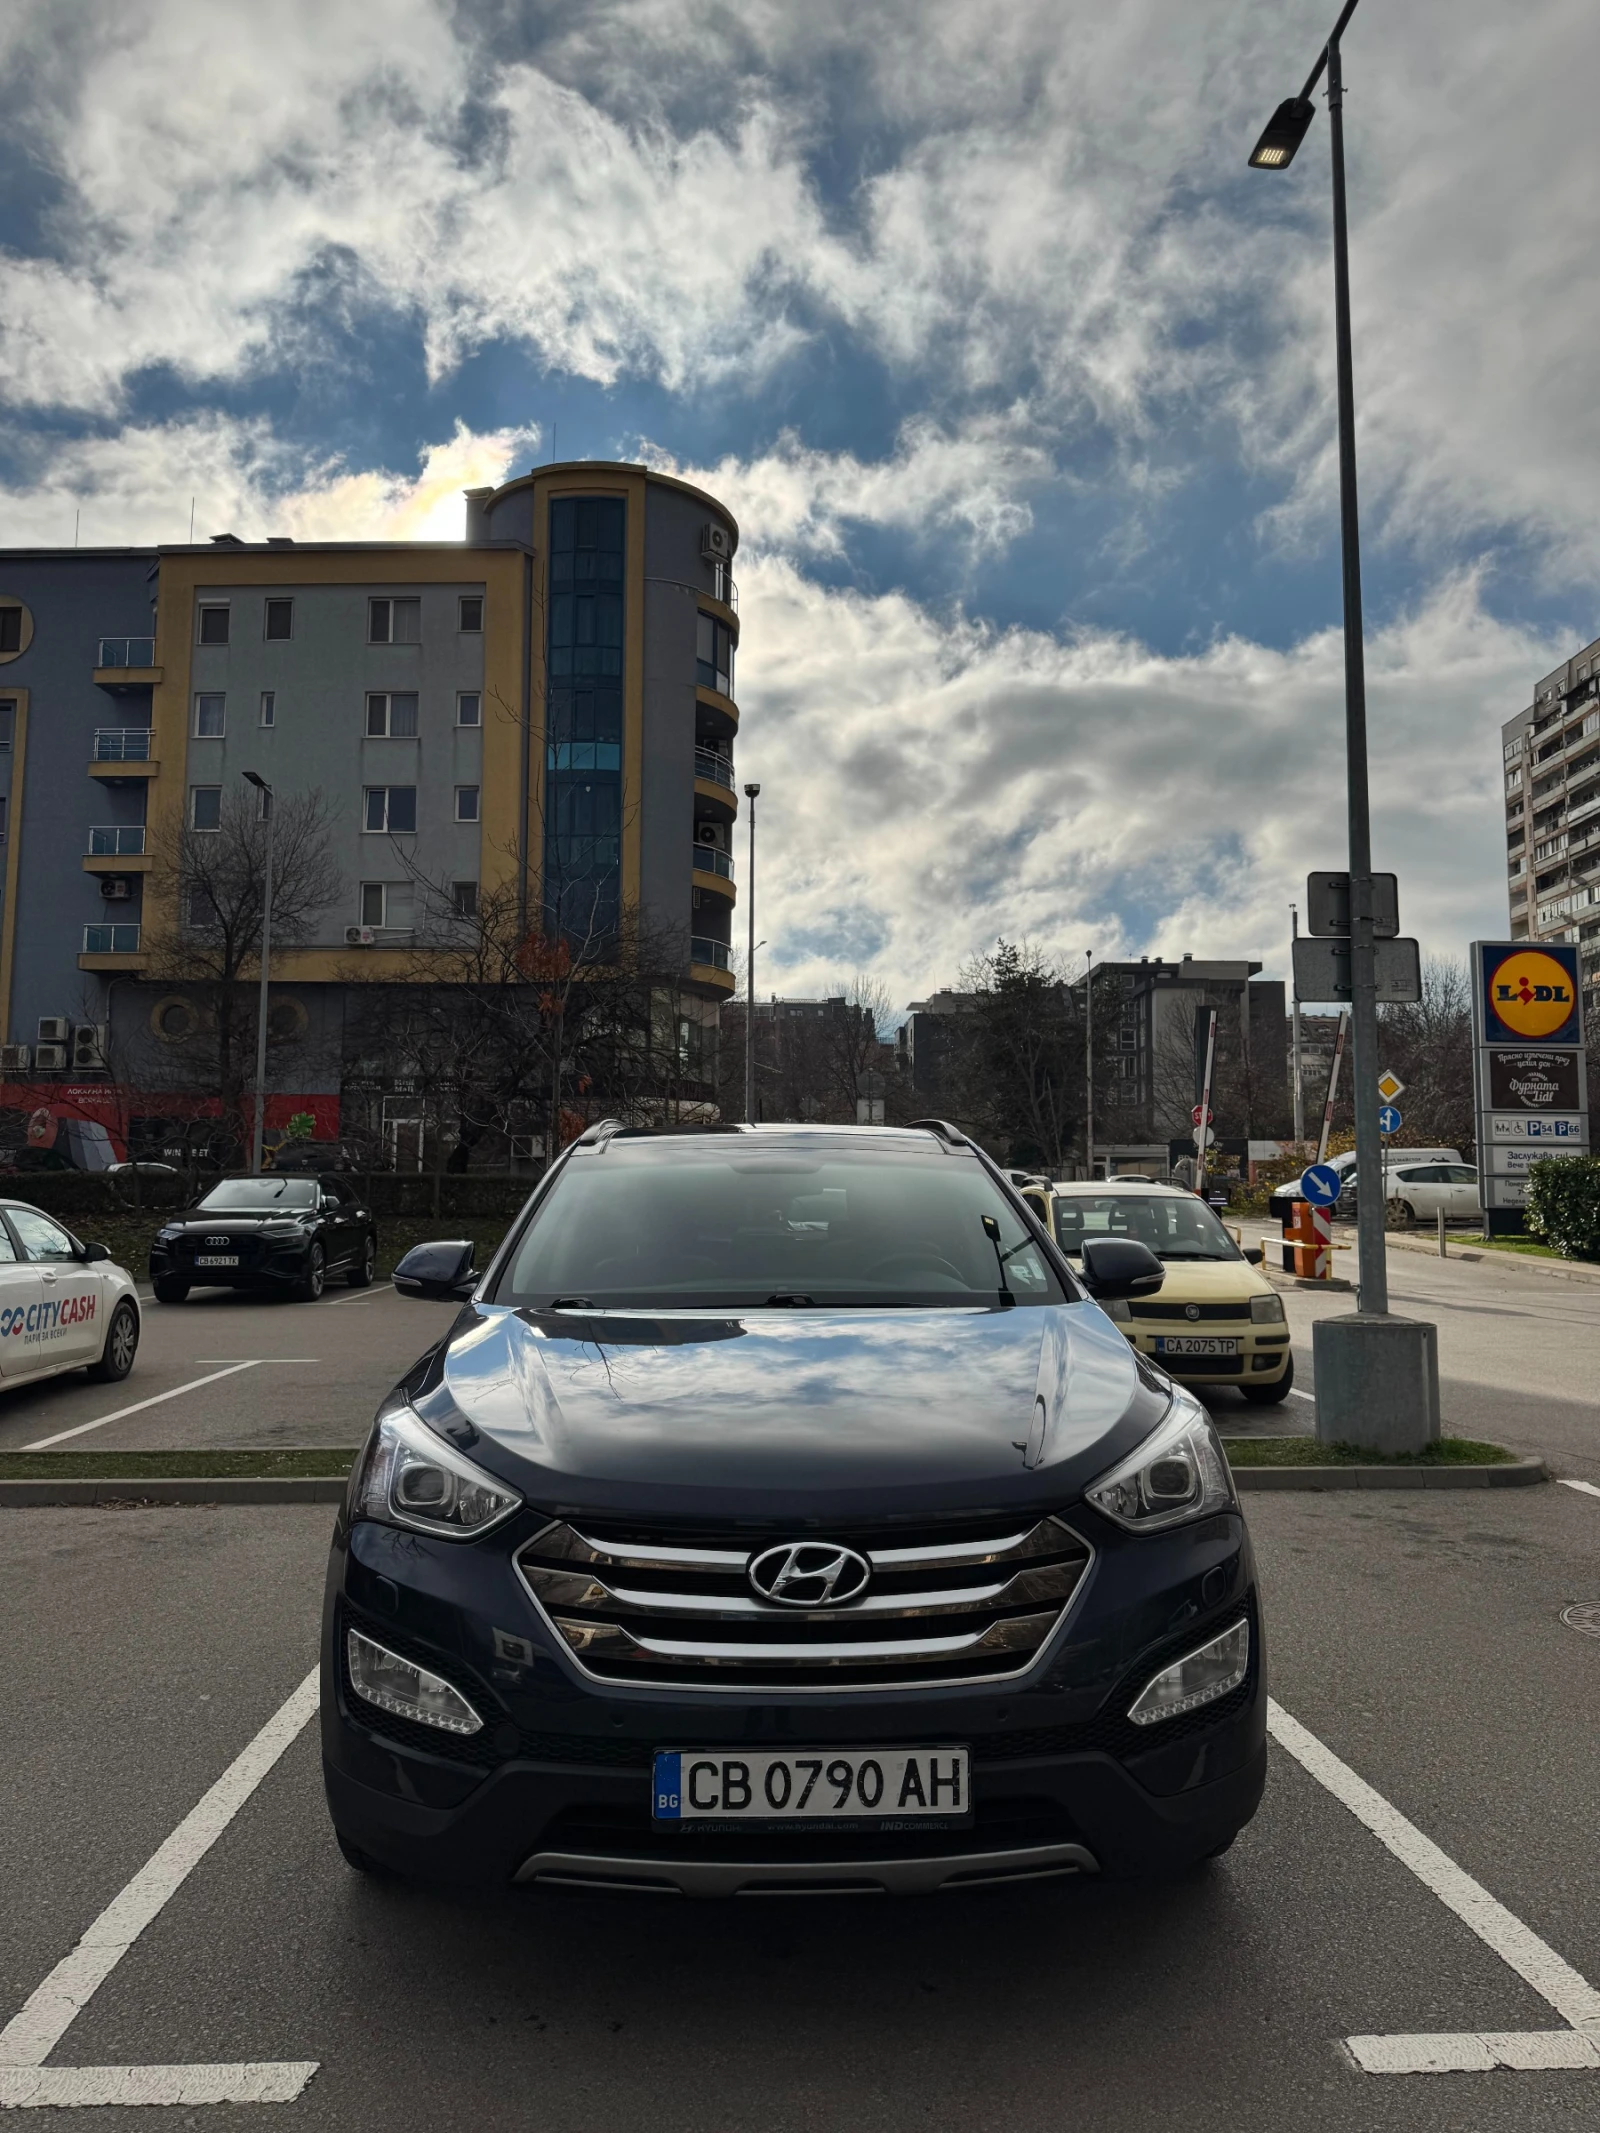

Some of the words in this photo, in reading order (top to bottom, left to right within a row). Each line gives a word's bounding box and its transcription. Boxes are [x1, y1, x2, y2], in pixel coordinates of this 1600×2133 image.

[1496, 977, 1570, 1006] LIDL
[1509, 1078, 1560, 1096] Фурната
[1532, 1091, 1555, 1102] Lidl
[1541, 1125, 1553, 1133] 54
[1568, 1125, 1580, 1133] 66
[210, 1257, 227, 1265] 6921
[1166, 1339, 1183, 1352] CA
[1185, 1339, 1216, 1353] 2075
[1218, 1340, 1235, 1353] TP
[658, 1795, 679, 1808] BG
[688, 1761, 752, 1810] CB
[764, 1759, 884, 1810] 0790
[897, 1757, 961, 1807] AH
